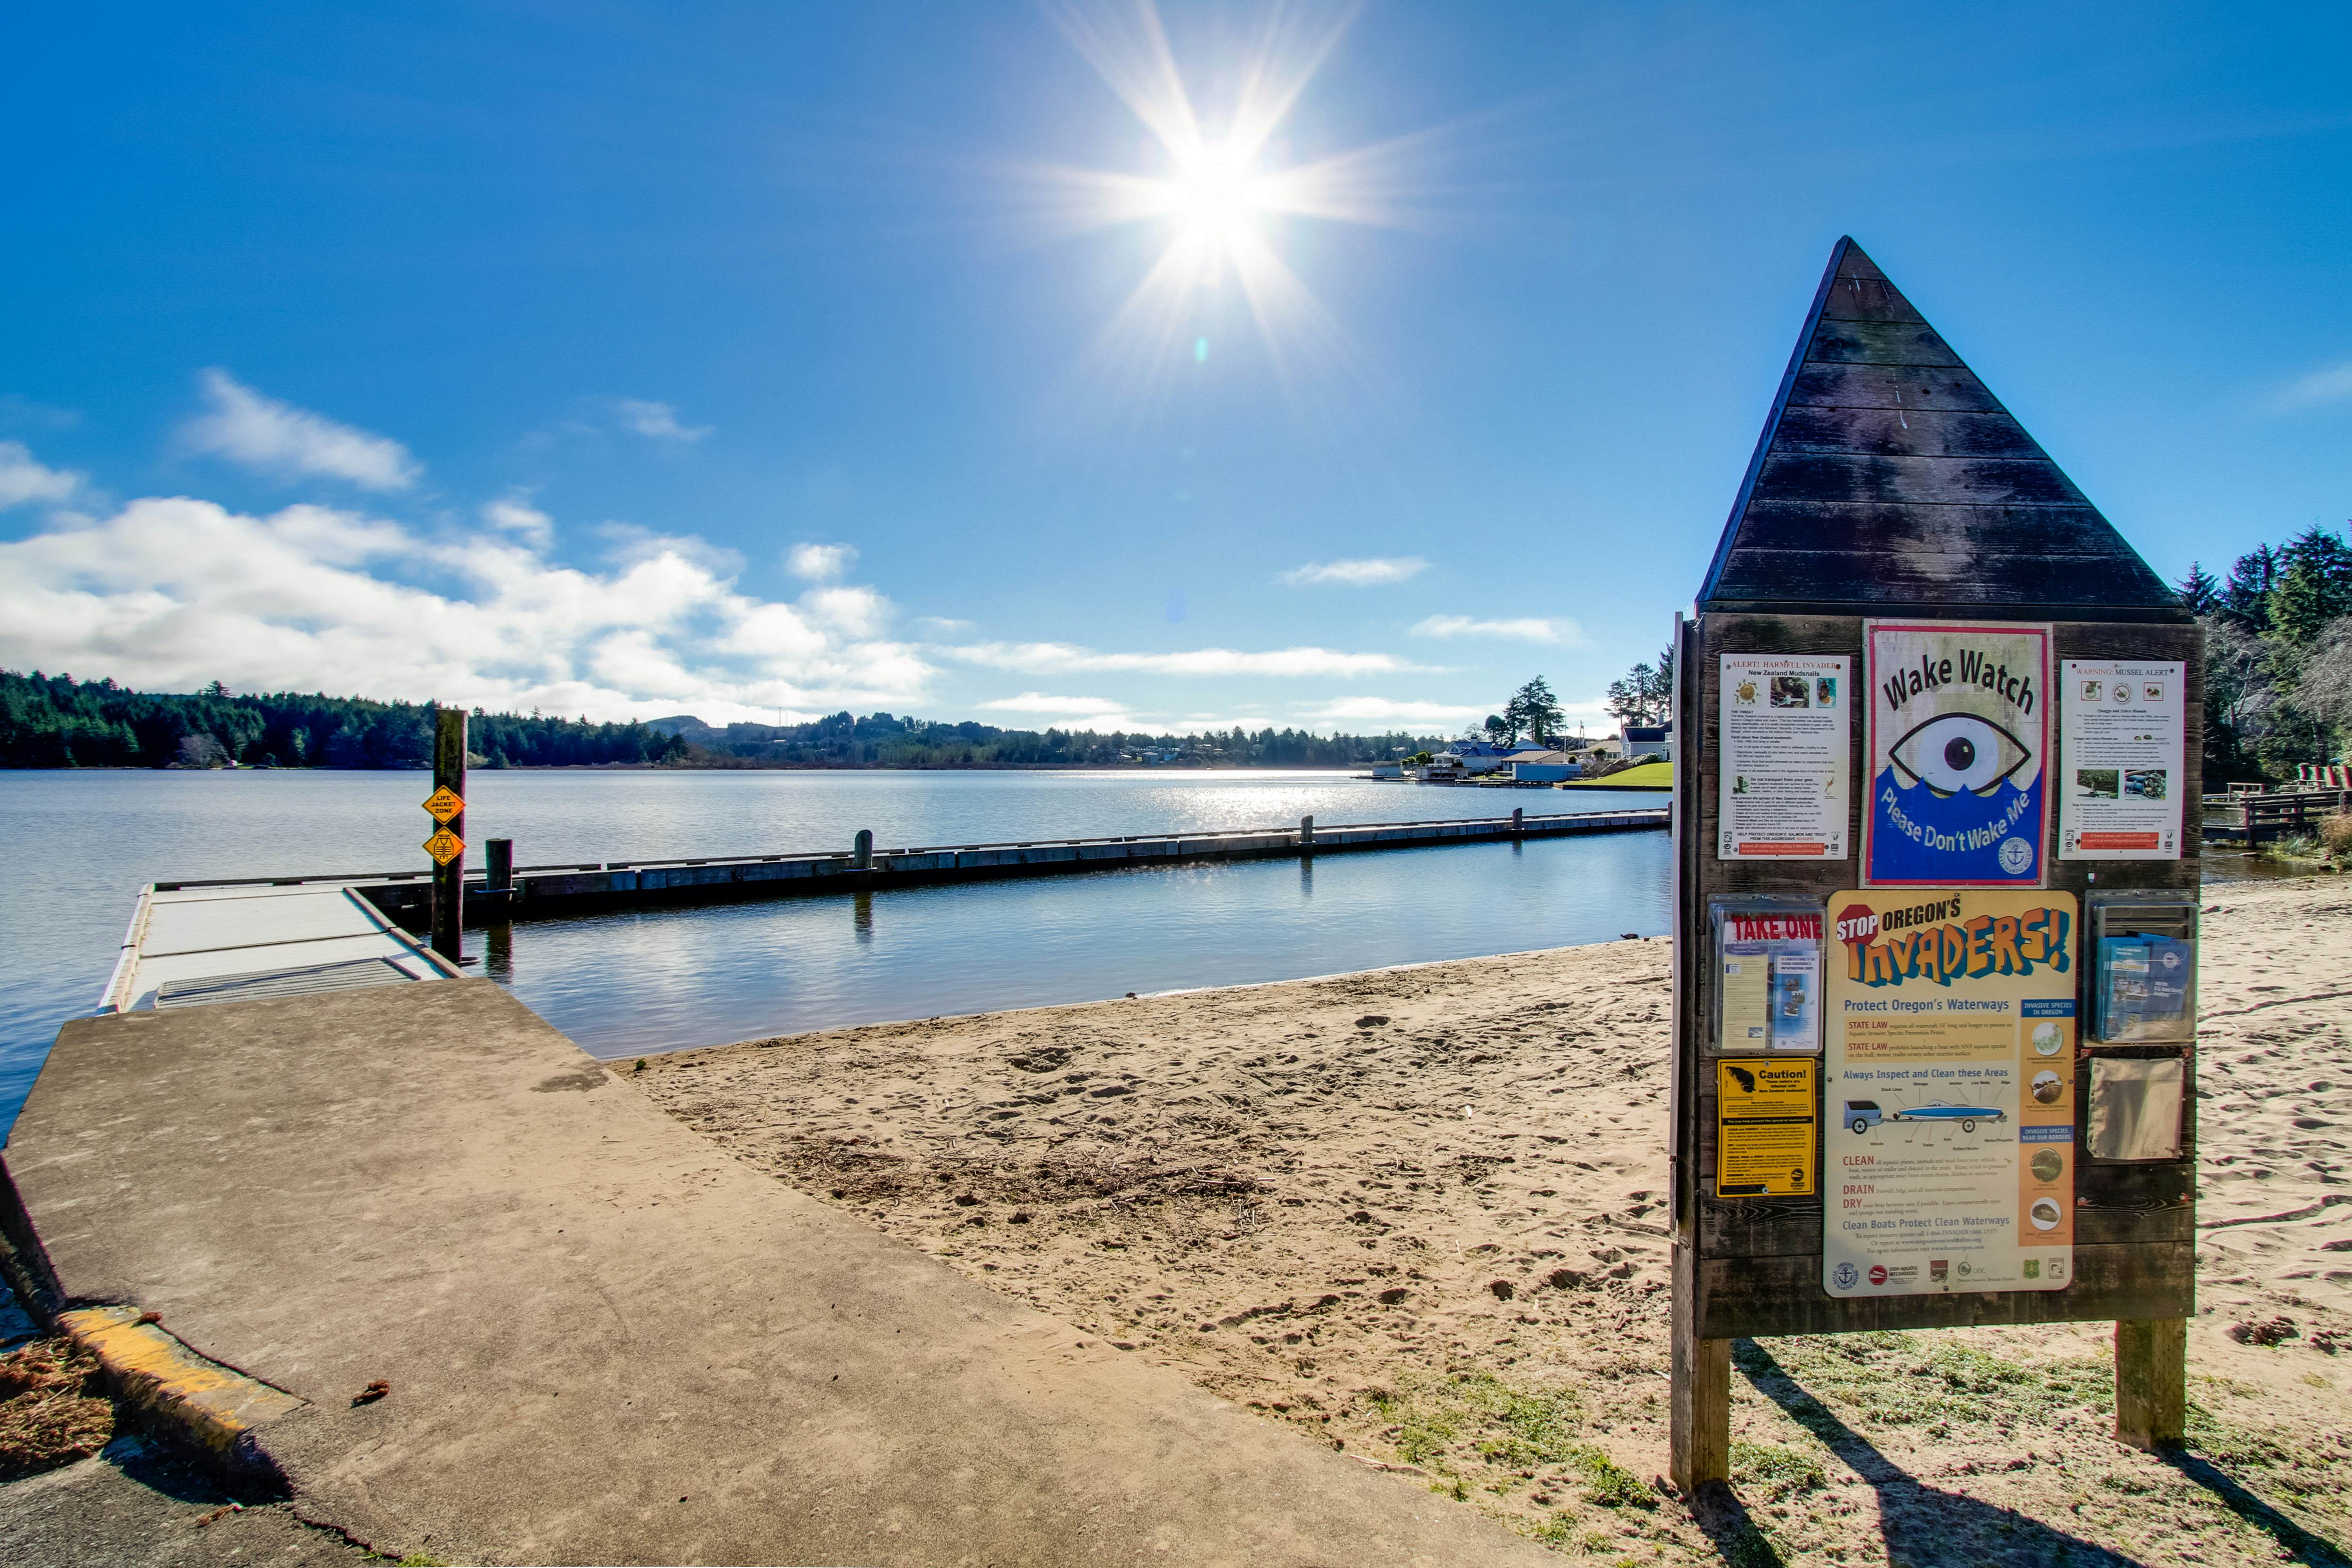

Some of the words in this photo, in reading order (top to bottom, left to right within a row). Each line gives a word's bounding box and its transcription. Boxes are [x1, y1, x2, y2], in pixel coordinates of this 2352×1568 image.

[1883, 654, 1952, 711] Wake
[1960, 649, 2033, 716] Watch
[1881, 786, 1922, 842] Please
[1924, 826, 1965, 851] Don't
[1967, 819, 2007, 850] Wake
[2007, 792, 2030, 825] Me
[1882, 897, 1961, 932] OREGON'S
[1732, 915, 1782, 940] TAKE
[1786, 915, 1823, 939] ONE
[1836, 913, 1878, 941] STOP
[1844, 1000, 1887, 1011] Protect
[1892, 999, 1942, 1013] Oregon's
[1947, 999, 2009, 1012] Waterways
[1759, 1070, 1806, 1079] Caution!
[1843, 1069, 1874, 1081] Always
[1876, 1069, 1909, 1080] Inspect
[1913, 1069, 1928, 1078] and
[1931, 1068, 1955, 1078] Clean
[1958, 1068, 1982, 1077] these
[1984, 1068, 2008, 1077] Areas
[1843, 1156, 1874, 1165] CLEAN
[1843, 1184, 1874, 1194] DRAIN
[1843, 1199, 1862, 1208] DRY
[1843, 1221, 1867, 1230] Clean
[1871, 1220, 1896, 1229] Boats
[1899, 1219, 1932, 1227] Protect
[1935, 1217, 1959, 1226] Clean
[1963, 1217, 2009, 1226] Waterways
